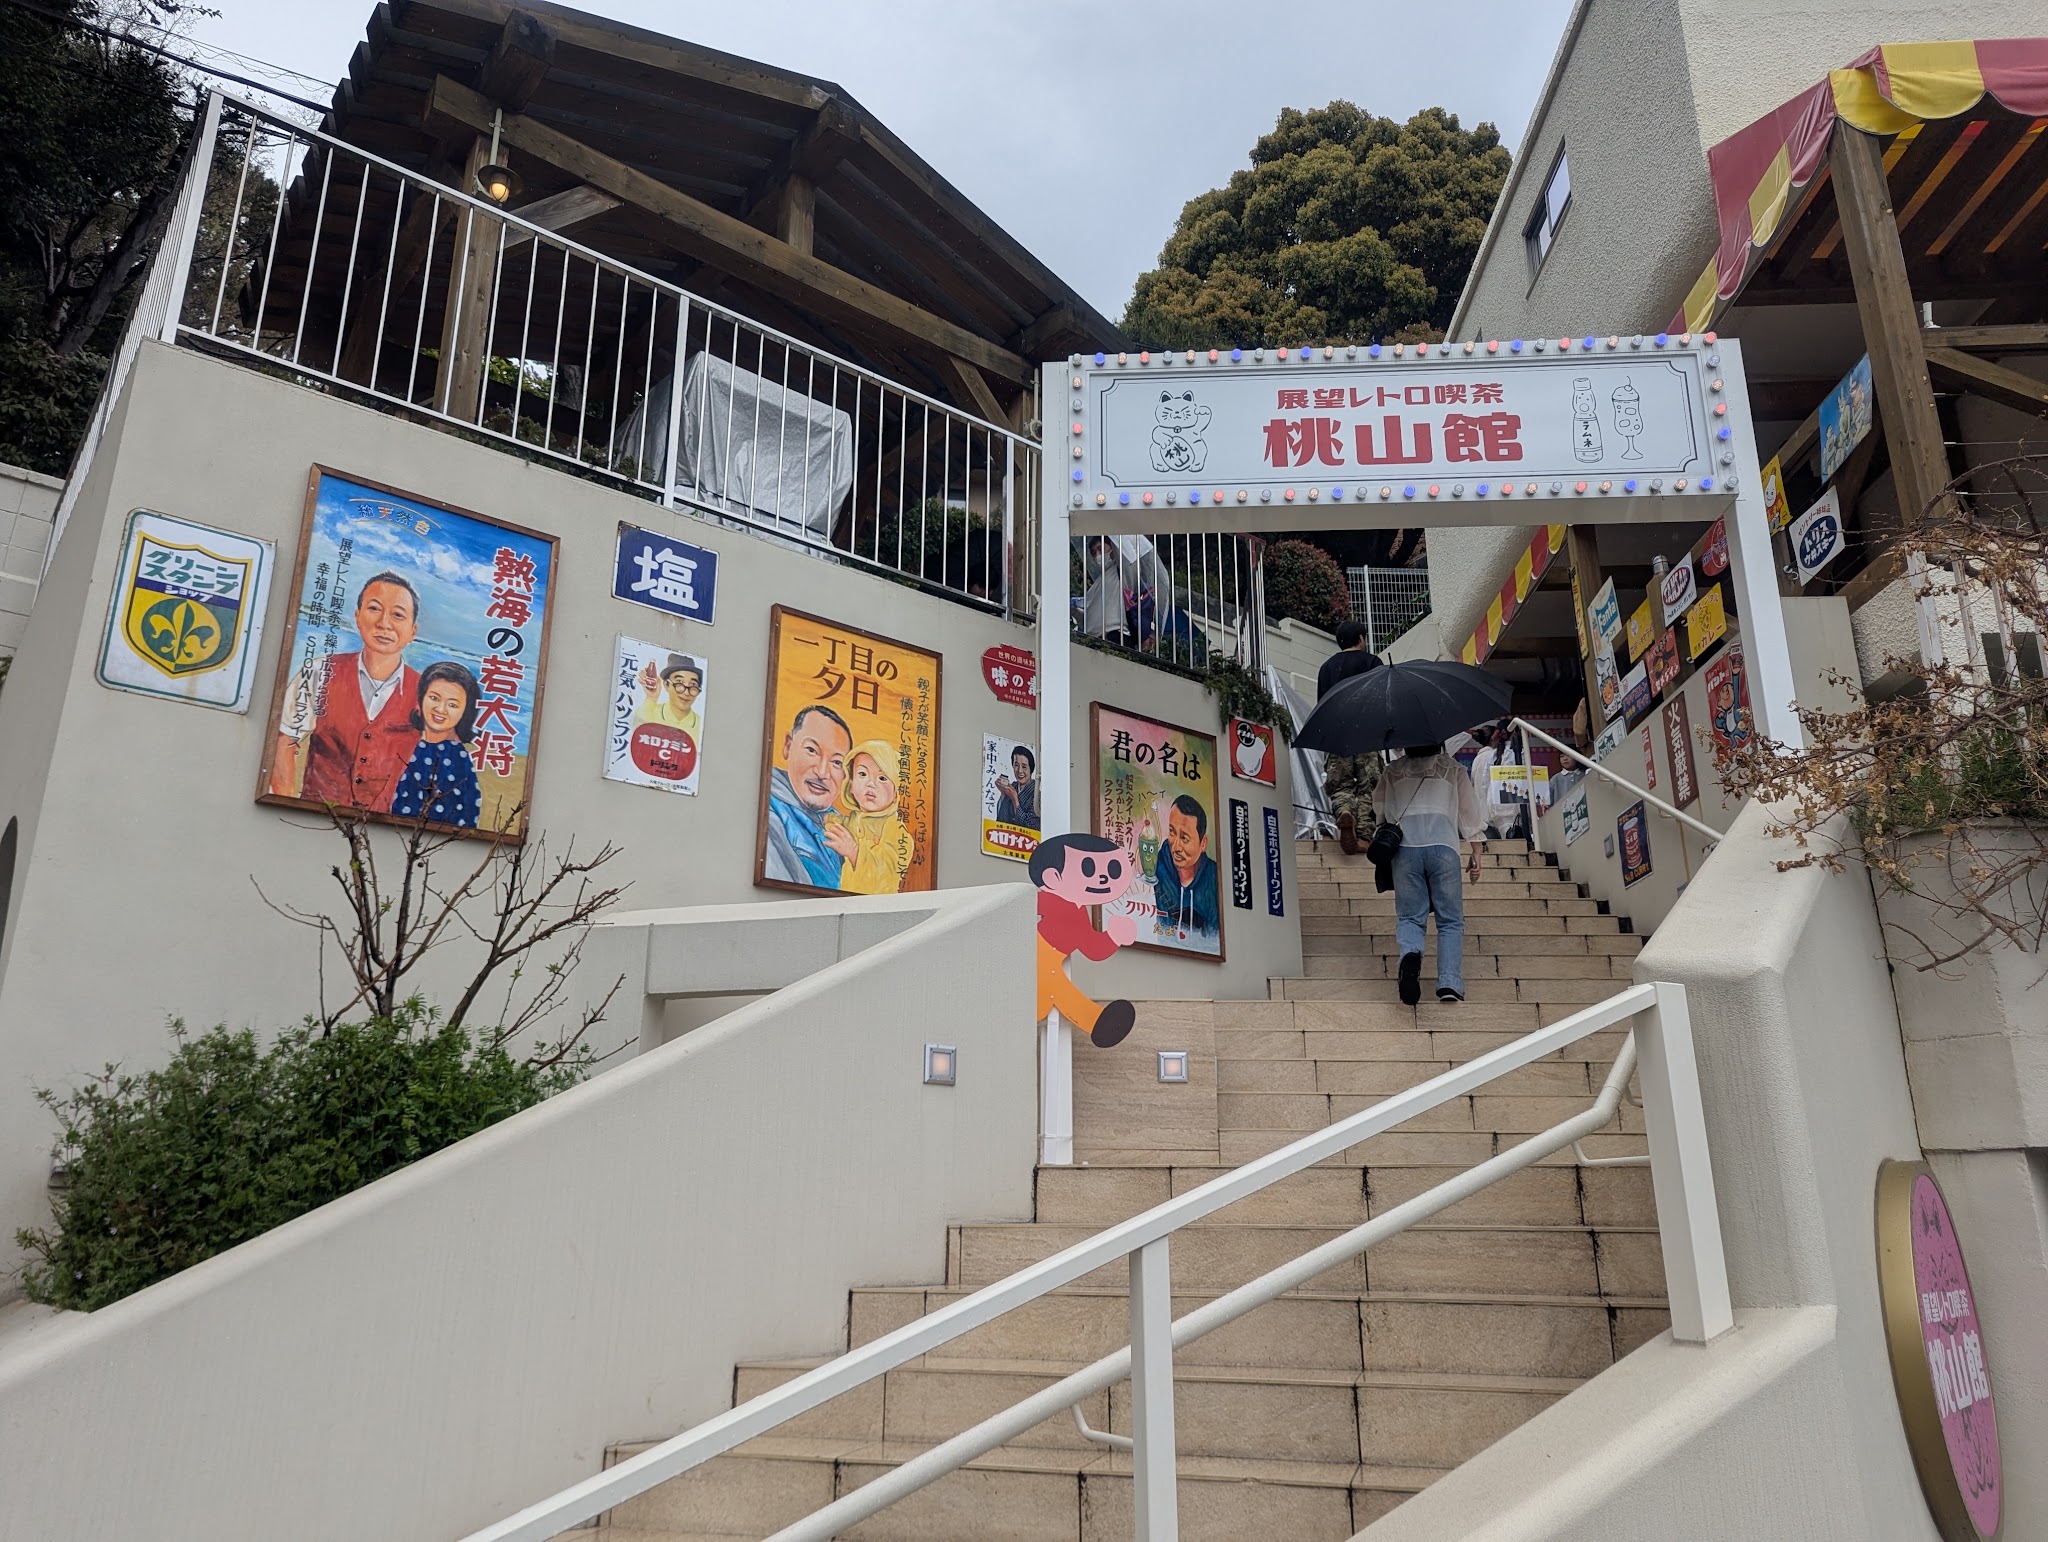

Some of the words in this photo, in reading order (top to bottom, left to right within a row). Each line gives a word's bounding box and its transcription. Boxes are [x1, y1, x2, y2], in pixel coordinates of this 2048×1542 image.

[1277, 383, 1504, 410] 展望レトロ喫茶
[1263, 411, 1524, 468] 桃山館
[1582, 421, 1593, 448] ラムネ
[1164, 443, 1190, 467] 桃山
[1805, 519, 1830, 552] トリス
[144, 562, 239, 595] スタンプ
[146, 550, 239, 580] グリーン
[630, 545, 700, 610] 塩
[164, 584, 214, 603] ショップ
[308, 561, 331, 628] 幸福の時間
[315, 537, 354, 718] 展望レトロ喫茶で繰り広げられる
[1597, 601, 1617, 635] Fanta
[1701, 624, 1723, 649] カレー
[470, 546, 537, 777] 熱海の若大将
[794, 635, 898, 681] 一丁目の
[812, 666, 880, 715] 夕日
[638, 733, 692, 753] オロナミン
[658, 751, 672, 761] C
[1110, 728, 1202, 781] 君の名は
[1668, 702, 1691, 802] 火気厳禁
[649, 759, 679, 771] ドリンク
[985, 740, 997, 813] 家中みんなで
[1236, 806, 1248, 904] 白玉ホワイトワイン
[1267, 815, 1281, 909] 白玉ホワイトワイン
[1153, 922, 1175, 936] だよ
[1921, 1288, 1970, 1324] 展望レトロ喫茶
[1928, 1329, 1990, 1420] 桃山館
